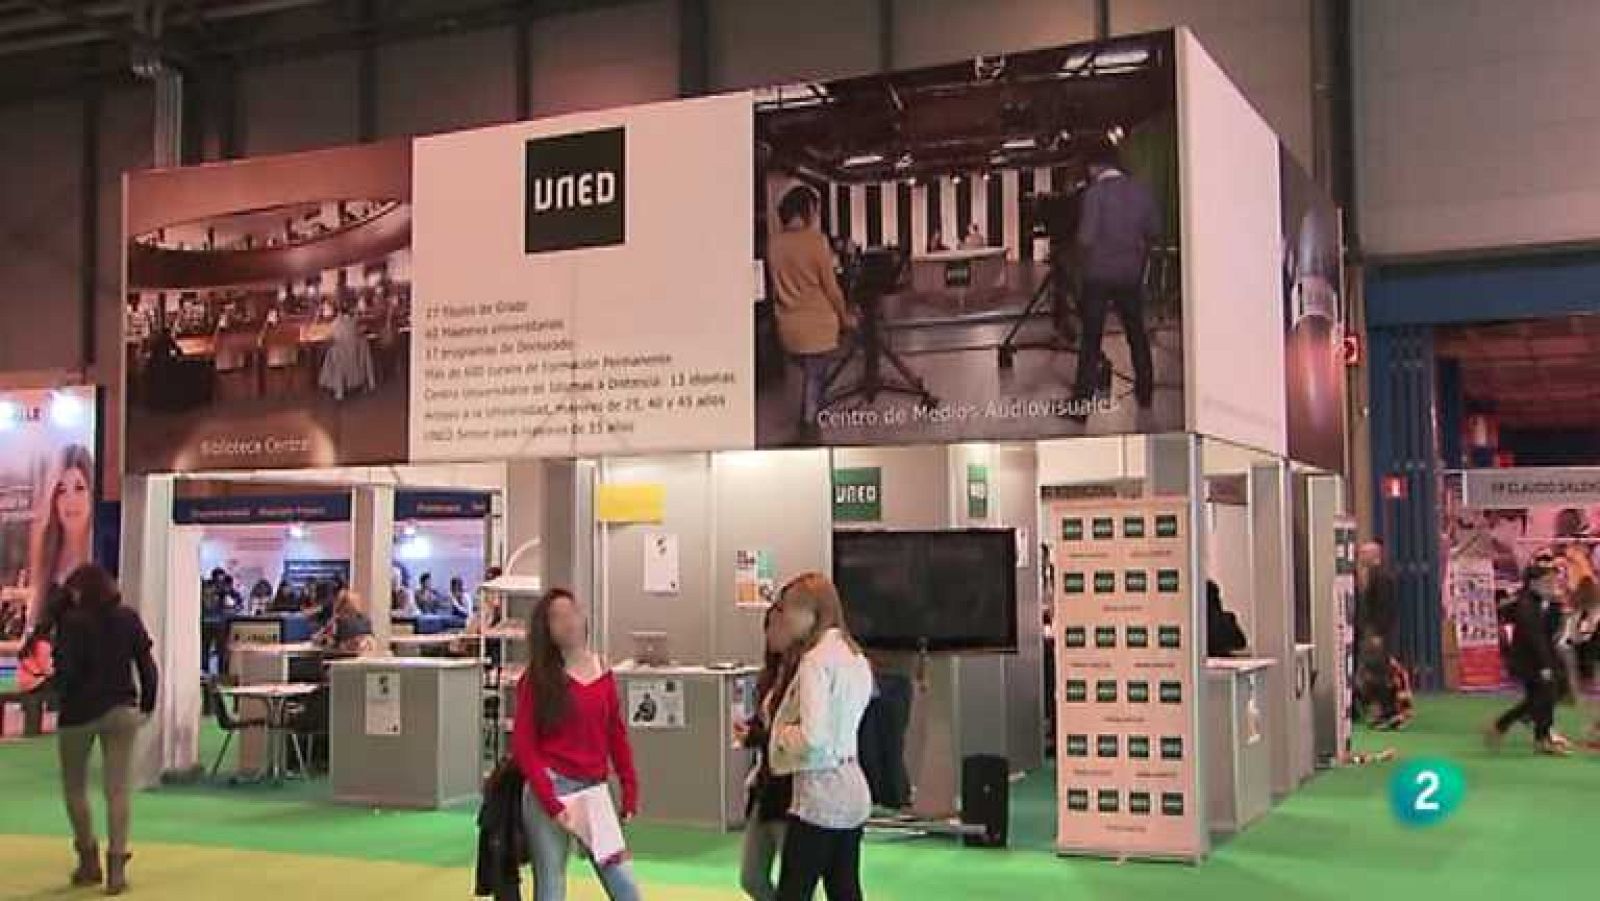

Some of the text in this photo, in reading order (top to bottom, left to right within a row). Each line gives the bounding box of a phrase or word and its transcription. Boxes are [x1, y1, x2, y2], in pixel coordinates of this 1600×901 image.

[534, 171, 616, 211] UNED
[817, 395, 1121, 430] Centro de Medios Audiovisuales
[201, 435, 309, 456] Biblioteca Central
